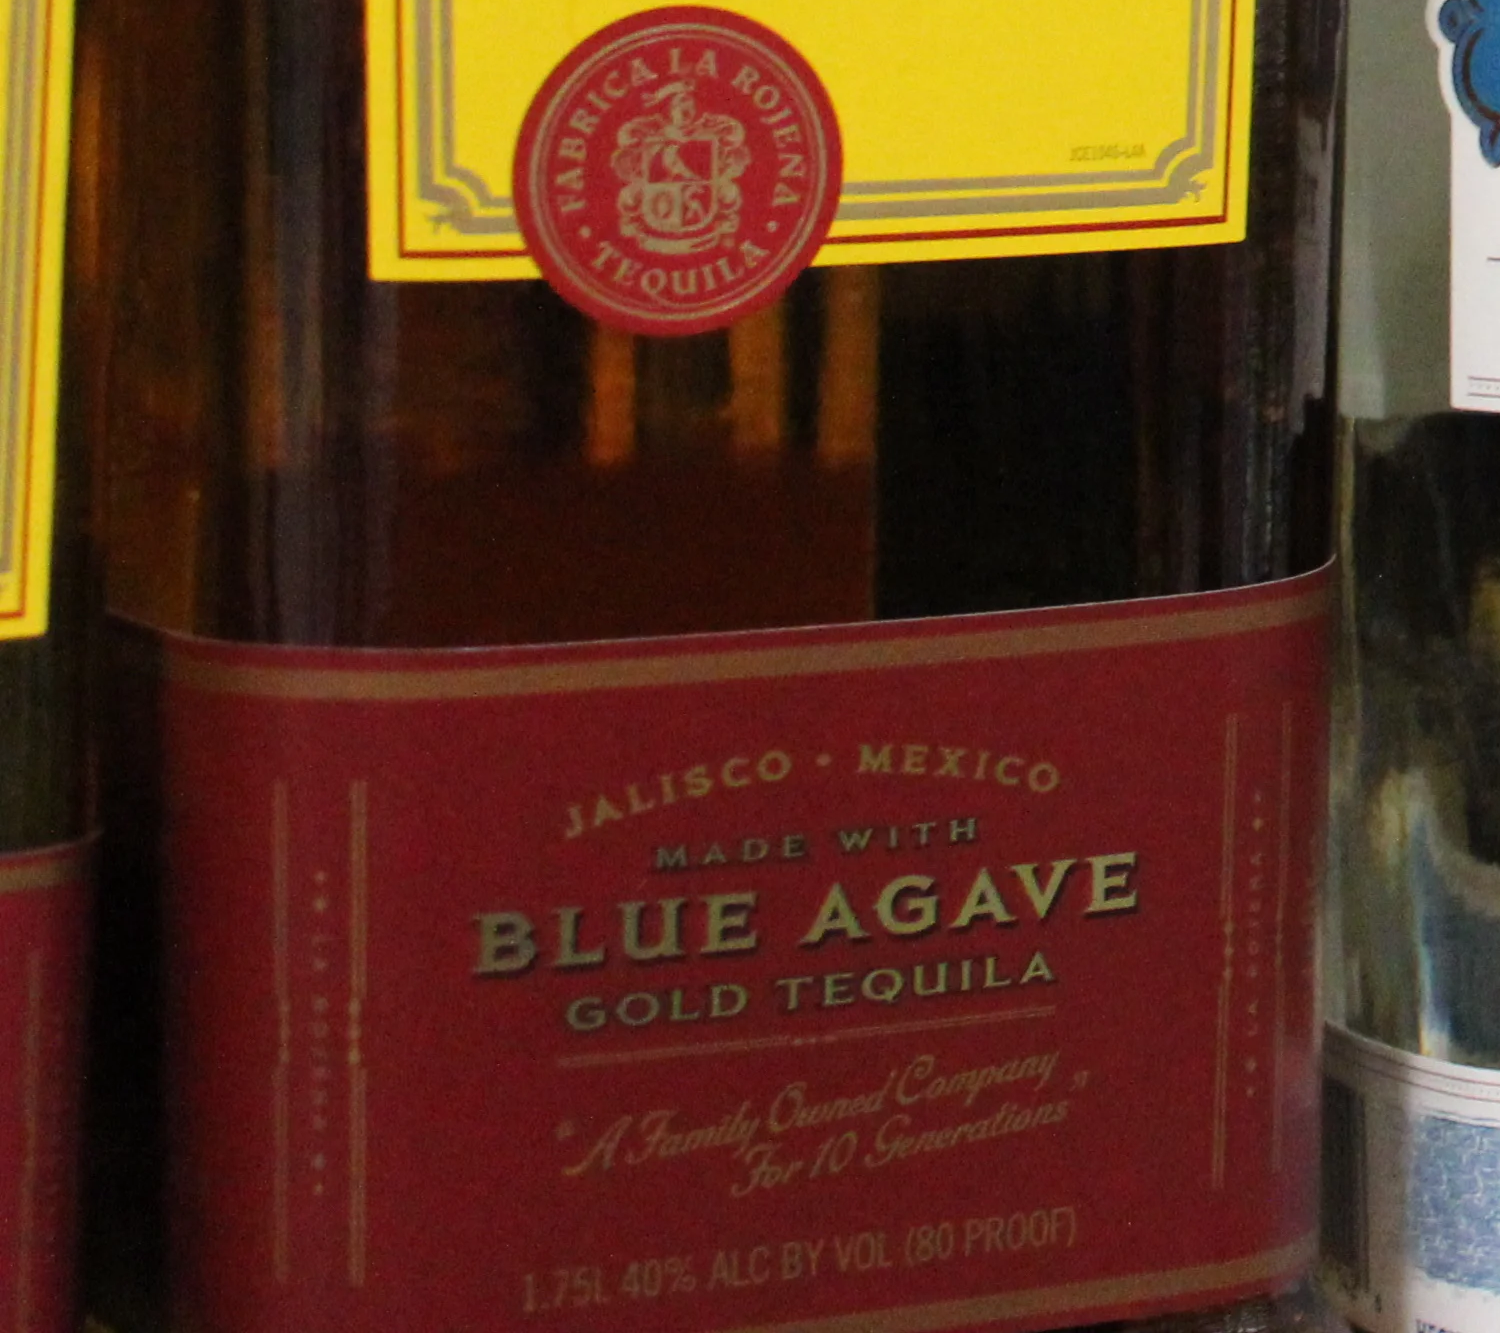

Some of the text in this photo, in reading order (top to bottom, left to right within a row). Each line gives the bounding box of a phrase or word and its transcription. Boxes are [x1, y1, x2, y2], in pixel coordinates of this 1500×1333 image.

[555, 55, 659, 213] FABRICA
[668, 47, 720, 80] LA
[591, 239, 770, 300] TEQUILA
[564, 742, 1062, 839] JALISCO MEXICO
[655, 818, 980, 871] MADE WITH
[470, 852, 1140, 976] BLUE AGAVE
[564, 951, 1058, 1032] GOLD TEQUILA
[627, 1100, 761, 1165] Family
[894, 1053, 1062, 1107] Company
[729, 1141, 805, 1199] For
[810, 1132, 858, 1180] 10
[621, 1254, 697, 1301] 40%
[707, 1245, 770, 1291] ALC
[780, 1238, 823, 1281] BY
[834, 1232, 895, 1274] VOL
